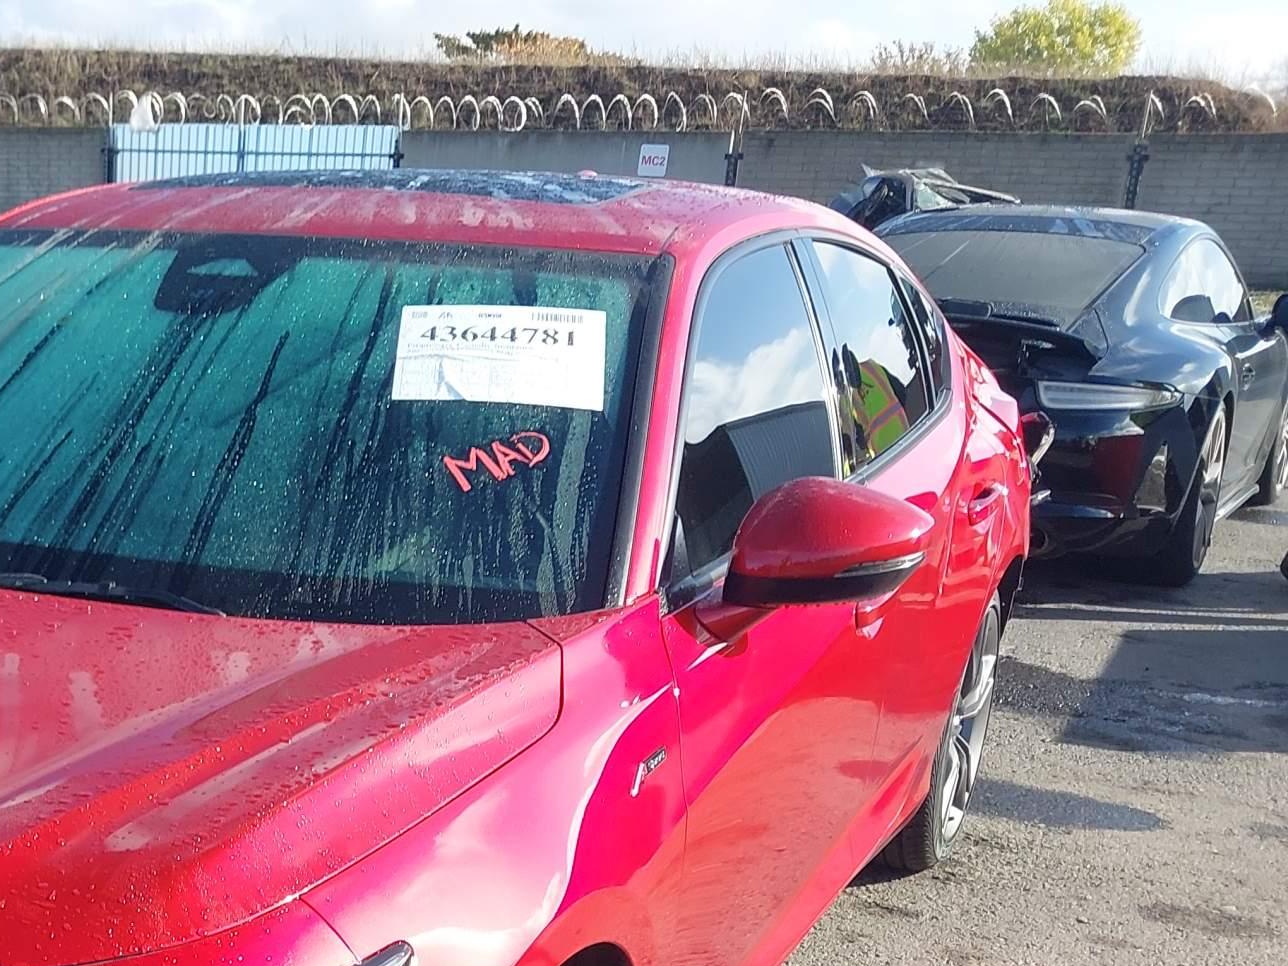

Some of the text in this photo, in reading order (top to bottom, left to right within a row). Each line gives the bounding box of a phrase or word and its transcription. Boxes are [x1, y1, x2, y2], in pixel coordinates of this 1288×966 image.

[641, 155, 666, 167] MC2
[420, 325, 575, 347] 43644781
[443, 431, 550, 492] MAD
